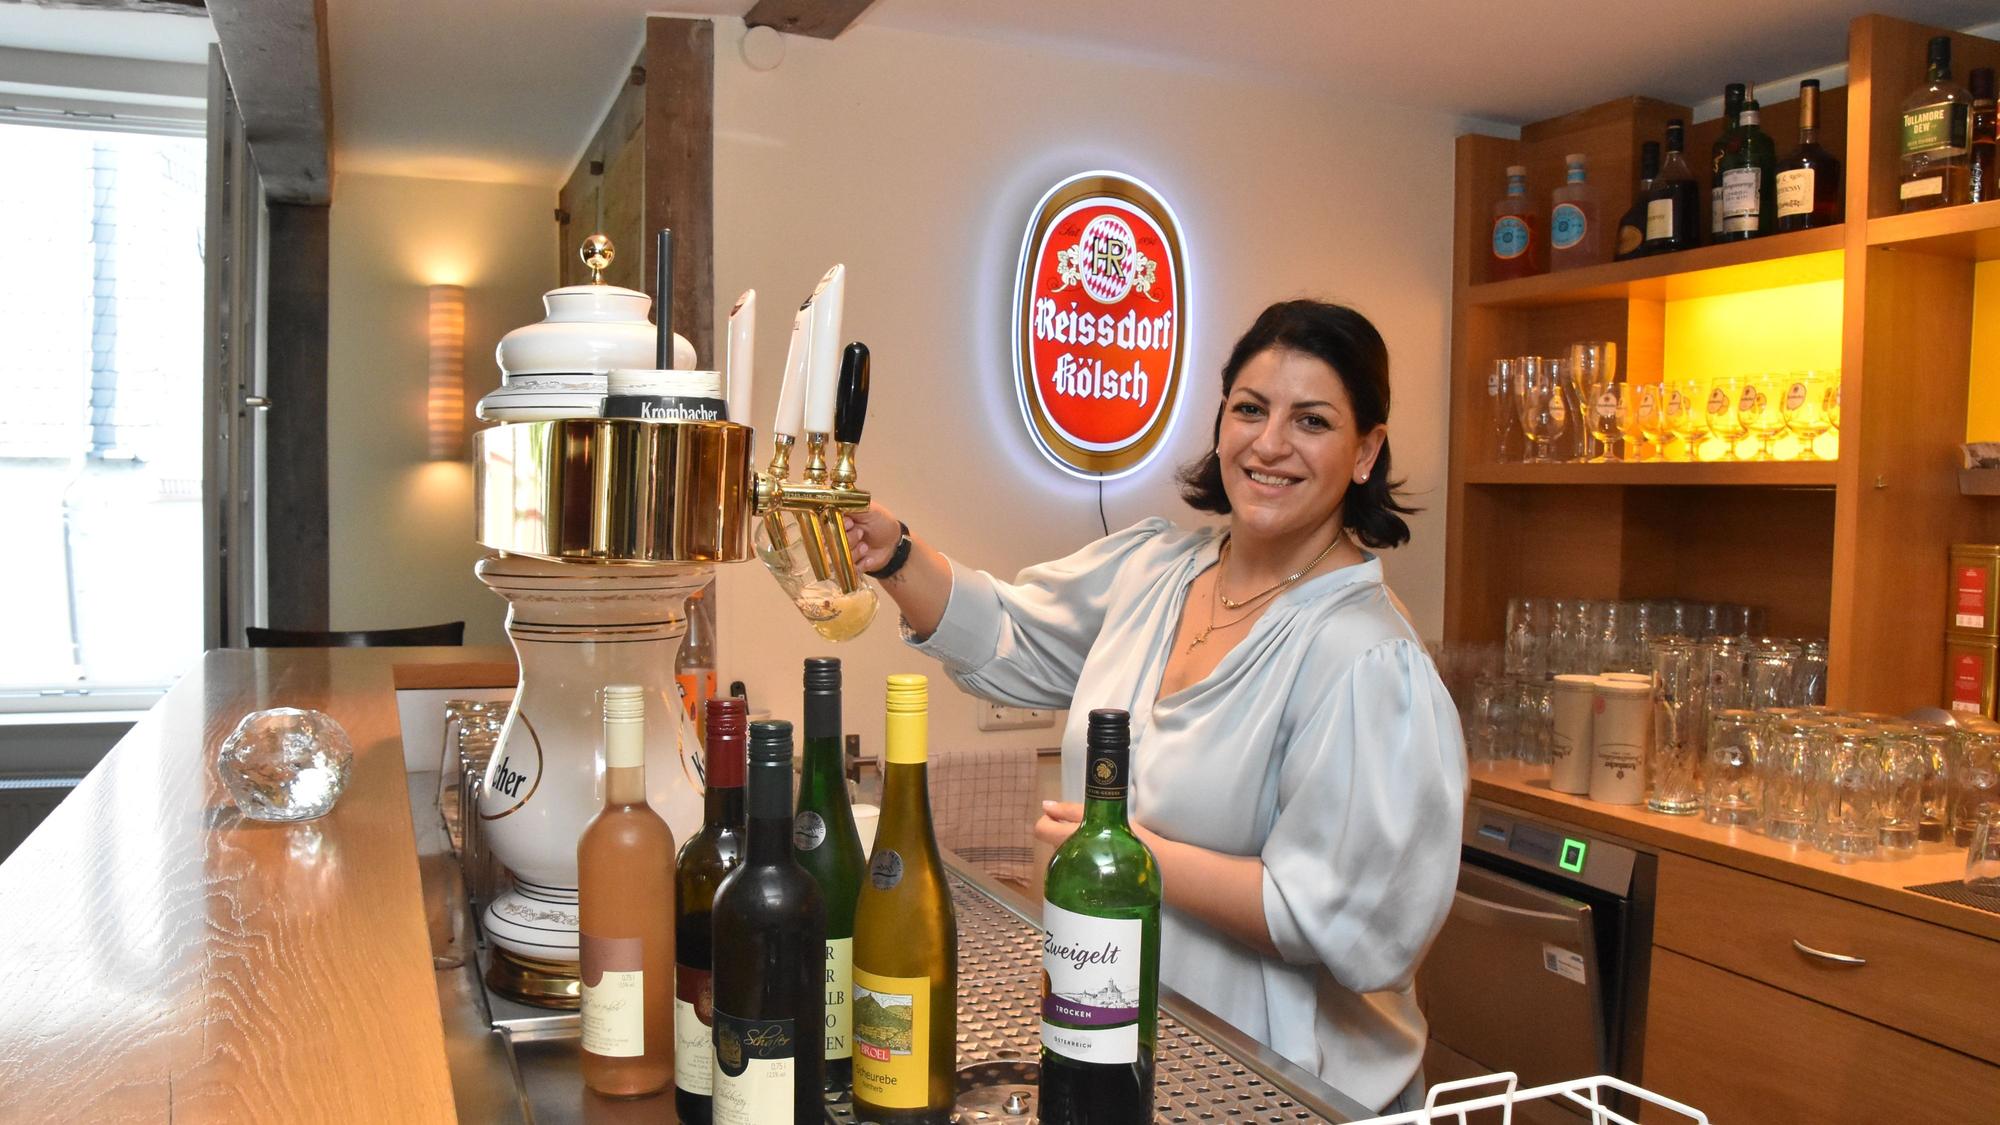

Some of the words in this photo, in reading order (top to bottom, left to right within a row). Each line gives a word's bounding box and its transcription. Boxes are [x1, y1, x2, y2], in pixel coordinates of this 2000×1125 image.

[1904, 109, 1945, 127] TULLAMORE
[1092, 236, 1126, 279] HR
[1034, 297, 1173, 351] Reissdorf
[1052, 352, 1148, 407] Kölsch
[641, 402, 718, 420] Krombacher
[1044, 930, 1120, 970] Zweigelt
[826, 991, 845, 1005] LB
[1056, 1005, 1092, 1019] TROCKEN
[1054, 1036, 1092, 1049] ÖSTERREICH
